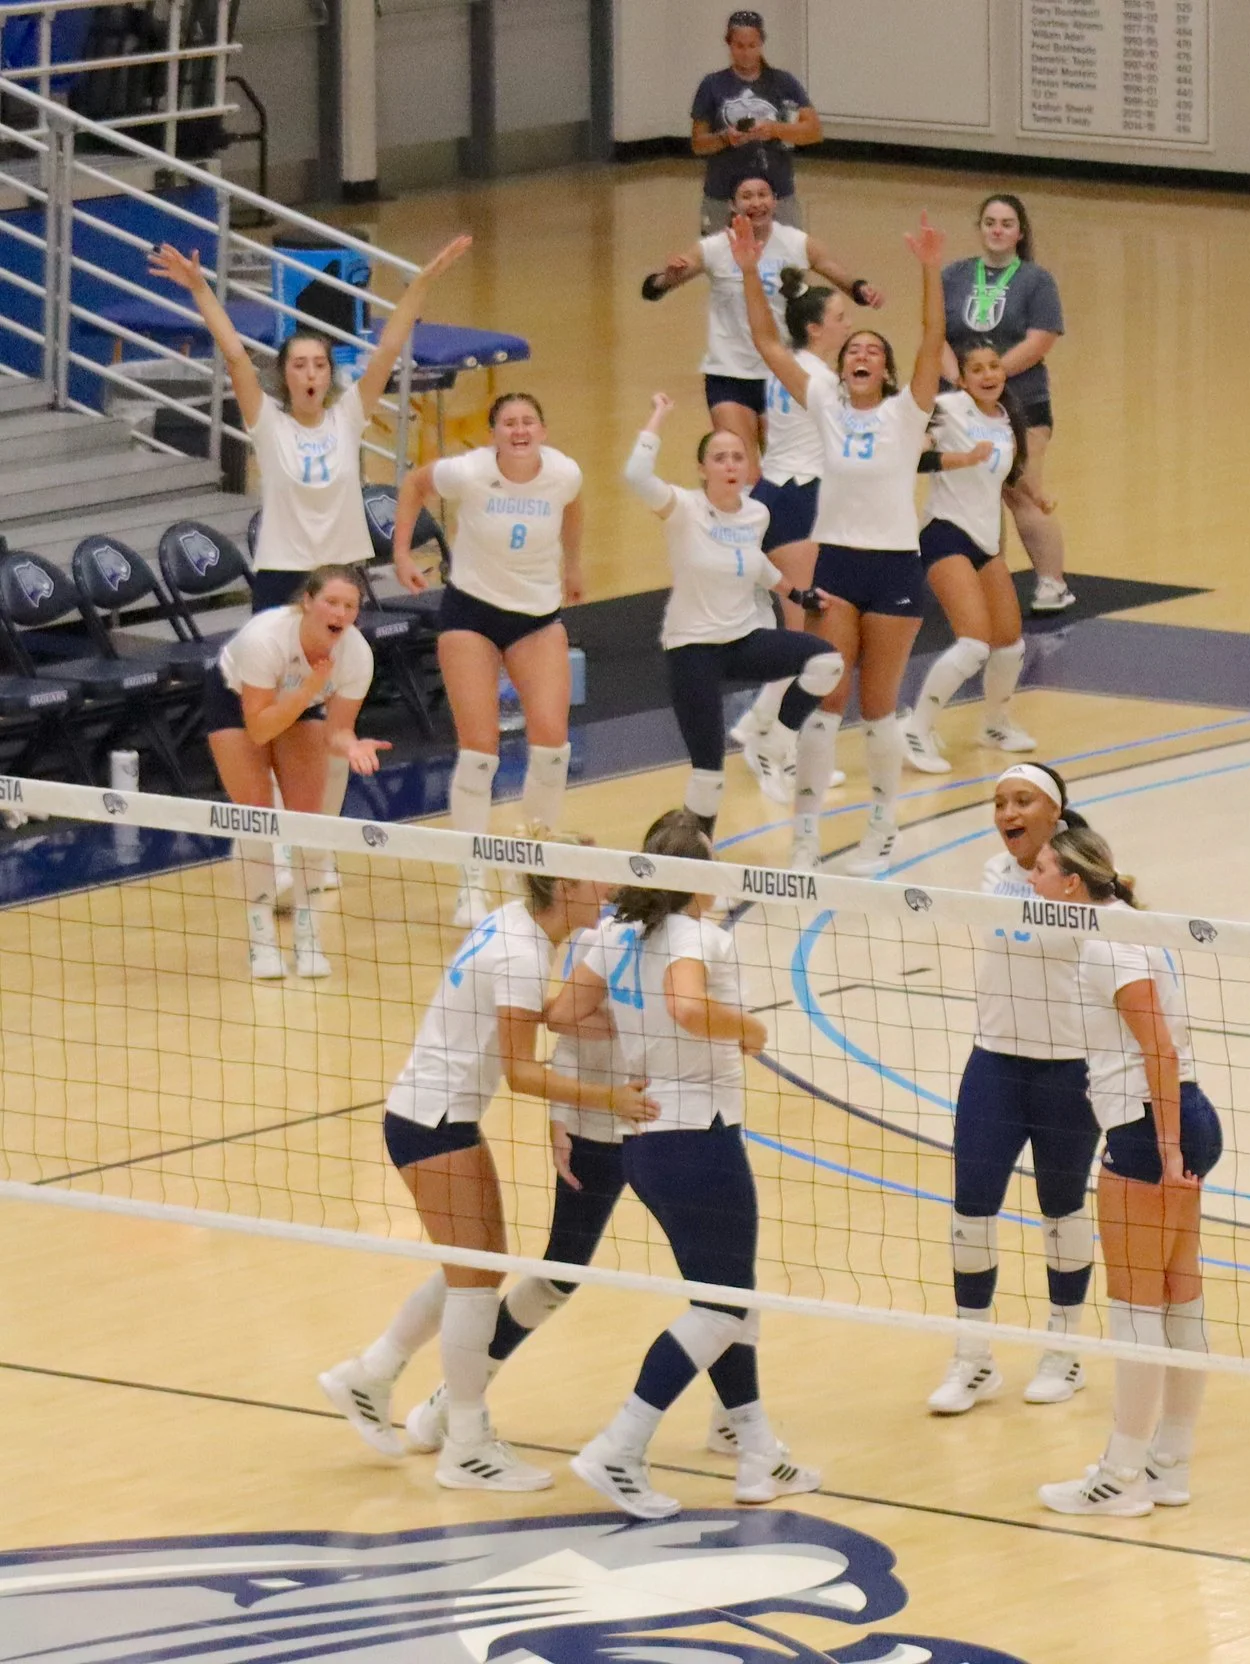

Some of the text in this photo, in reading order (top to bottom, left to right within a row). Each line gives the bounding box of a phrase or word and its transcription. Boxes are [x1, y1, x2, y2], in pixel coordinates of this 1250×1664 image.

[843, 433, 875, 460] 13
[302, 455, 330, 483] 11
[484, 496, 551, 517] AUGUSTA
[509, 523, 528, 550] 8
[210, 805, 280, 837] AUGUSTA
[472, 836, 545, 868] AUGUSTA
[742, 869, 818, 901] AUGUSTA
[1022, 900, 1100, 931] AUGUSTA
